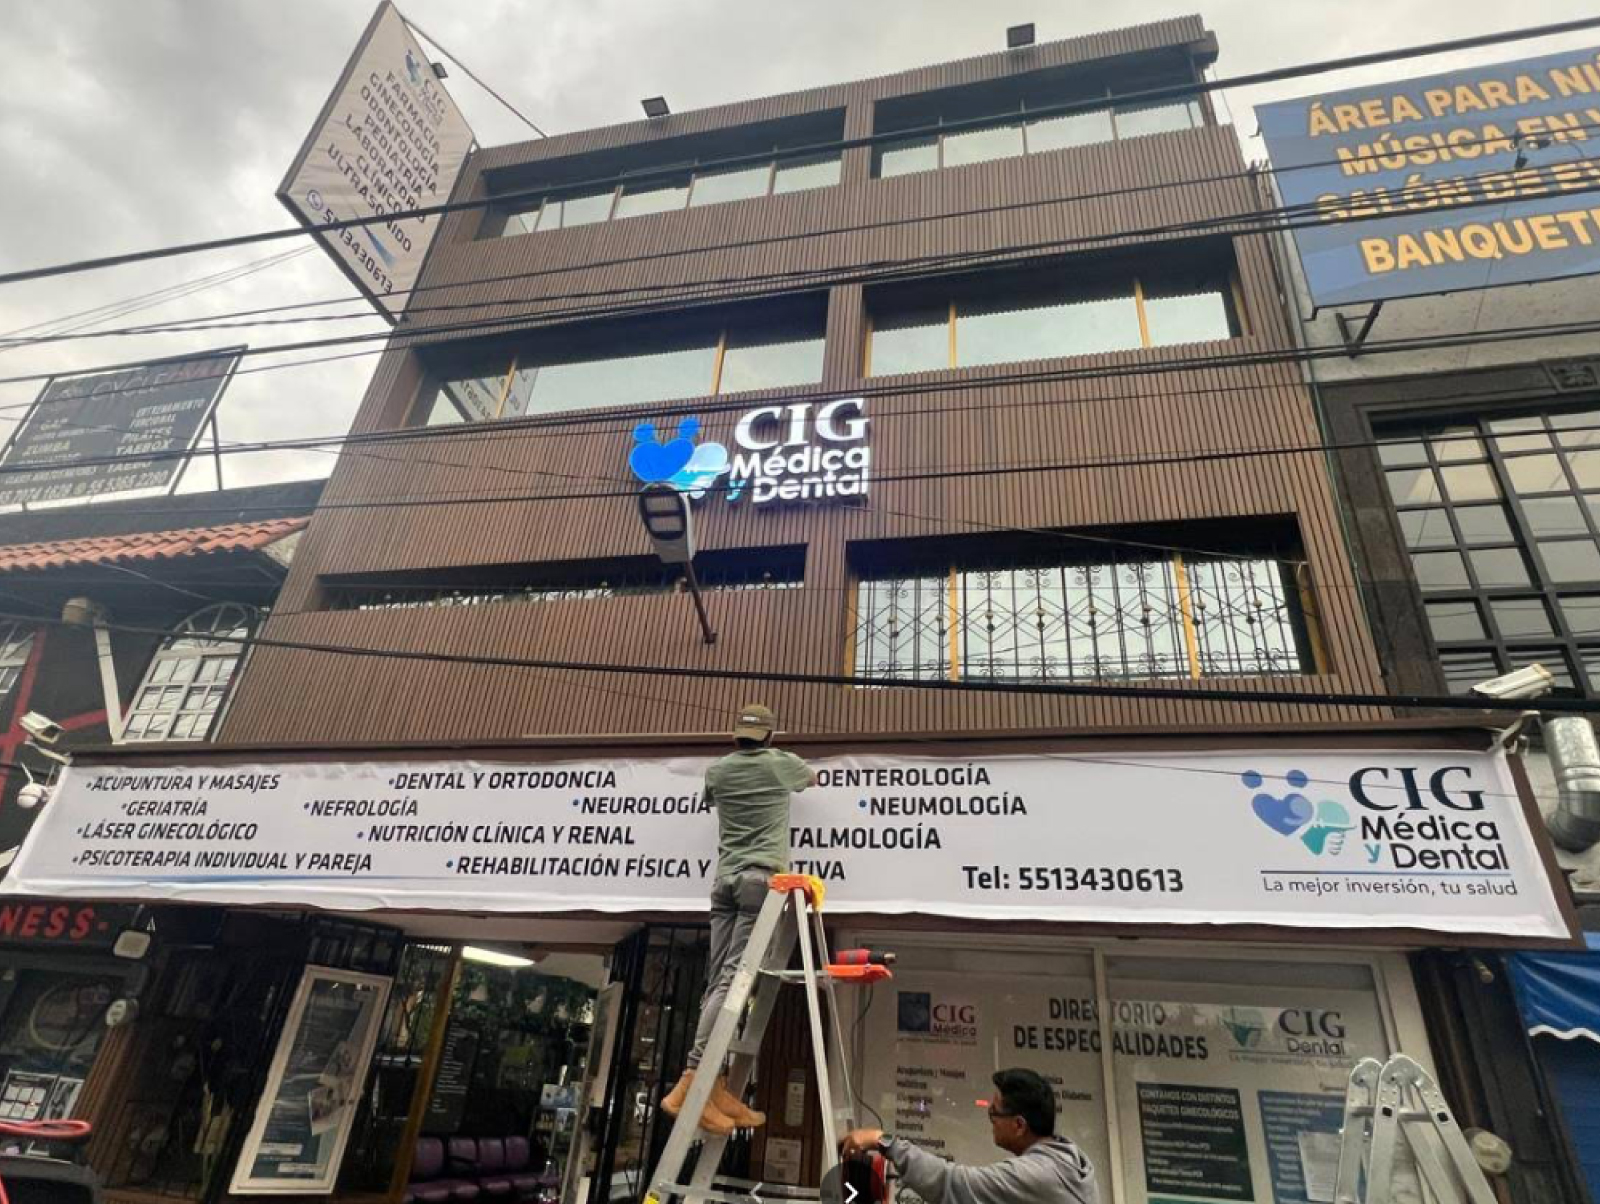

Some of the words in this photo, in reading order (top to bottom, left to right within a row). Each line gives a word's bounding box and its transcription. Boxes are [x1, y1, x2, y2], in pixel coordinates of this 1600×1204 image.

[1309, 101, 1423, 136] ÁREA
[1424, 75, 1550, 116] PARA
[1550, 54, 1600, 96] NI
[370, 72, 440, 176] GINECOLOGÍA
[386, 71, 440, 155] FARMACIA
[361, 86, 438, 196] ODONTOLOGÍA
[1337, 124, 1513, 175] MÚSICA
[1517, 112, 1588, 142] EN
[364, 115, 423, 198] PEDIATRÍA
[357, 155, 405, 215] CLÍNICO
[1479, 169, 1548, 200] DE
[322, 208, 394, 295] 513430613
[735, 398, 870, 450] CIG
[730, 446, 870, 479] Médica
[725, 480, 746, 501] y
[752, 469, 869, 503] Dental
[91, 775, 193, 792] ACUPUNTURA
[197, 776, 207, 791] Y
[208, 774, 282, 795] MASAJES
[394, 772, 466, 790] DENTAL
[471, 772, 485, 790] Y
[488, 770, 617, 790] ORTODONCIA
[816, 762, 991, 787] OENTEROLOGÍA
[1349, 767, 1485, 811] CIG
[126, 797, 208, 816] GERIATRÍA
[309, 796, 418, 816] NEFROLOGÍA
[581, 792, 712, 815] NEUROLOGÍA
[869, 792, 1027, 816] NEUMOLOGÍA
[82, 820, 135, 840] LÁSER
[137, 820, 258, 841] GINECOLÓGICO
[368, 821, 468, 843] NUTRICIÓN
[472, 821, 545, 844] CLÍNICA
[552, 825, 565, 844] Y
[567, 825, 635, 845] RENAL
[790, 823, 941, 849] TALMOLOGÍA
[1361, 813, 1500, 841] Médica
[78, 850, 191, 868] PSICOTERAPIA
[194, 851, 288, 870] INDIVIDUAL
[293, 852, 305, 870] Y
[307, 853, 372, 876] PAREJA
[456, 853, 620, 877] REHABILITACIÓN
[625, 854, 691, 878] FÍSICA
[697, 858, 712, 878] Y
[1364, 844, 1380, 863] y
[1390, 843, 1510, 870] Dental
[962, 866, 1010, 889] Tel:
[1019, 866, 1184, 893] 5513430613
[1263, 878, 1283, 893] La
[1288, 878, 1340, 898] mejor
[1346, 878, 1435, 896] inversión,
[1440, 880, 1462, 895] tu
[1466, 879, 1518, 896] salud
[932, 1003, 976, 1024] CIG
[1279, 1009, 1345, 1038] CIG
[1014, 1025, 1039, 1050] DE
[1044, 1027, 1209, 1060] ESPECALIDADES
[1287, 1037, 1345, 1056] Dental
